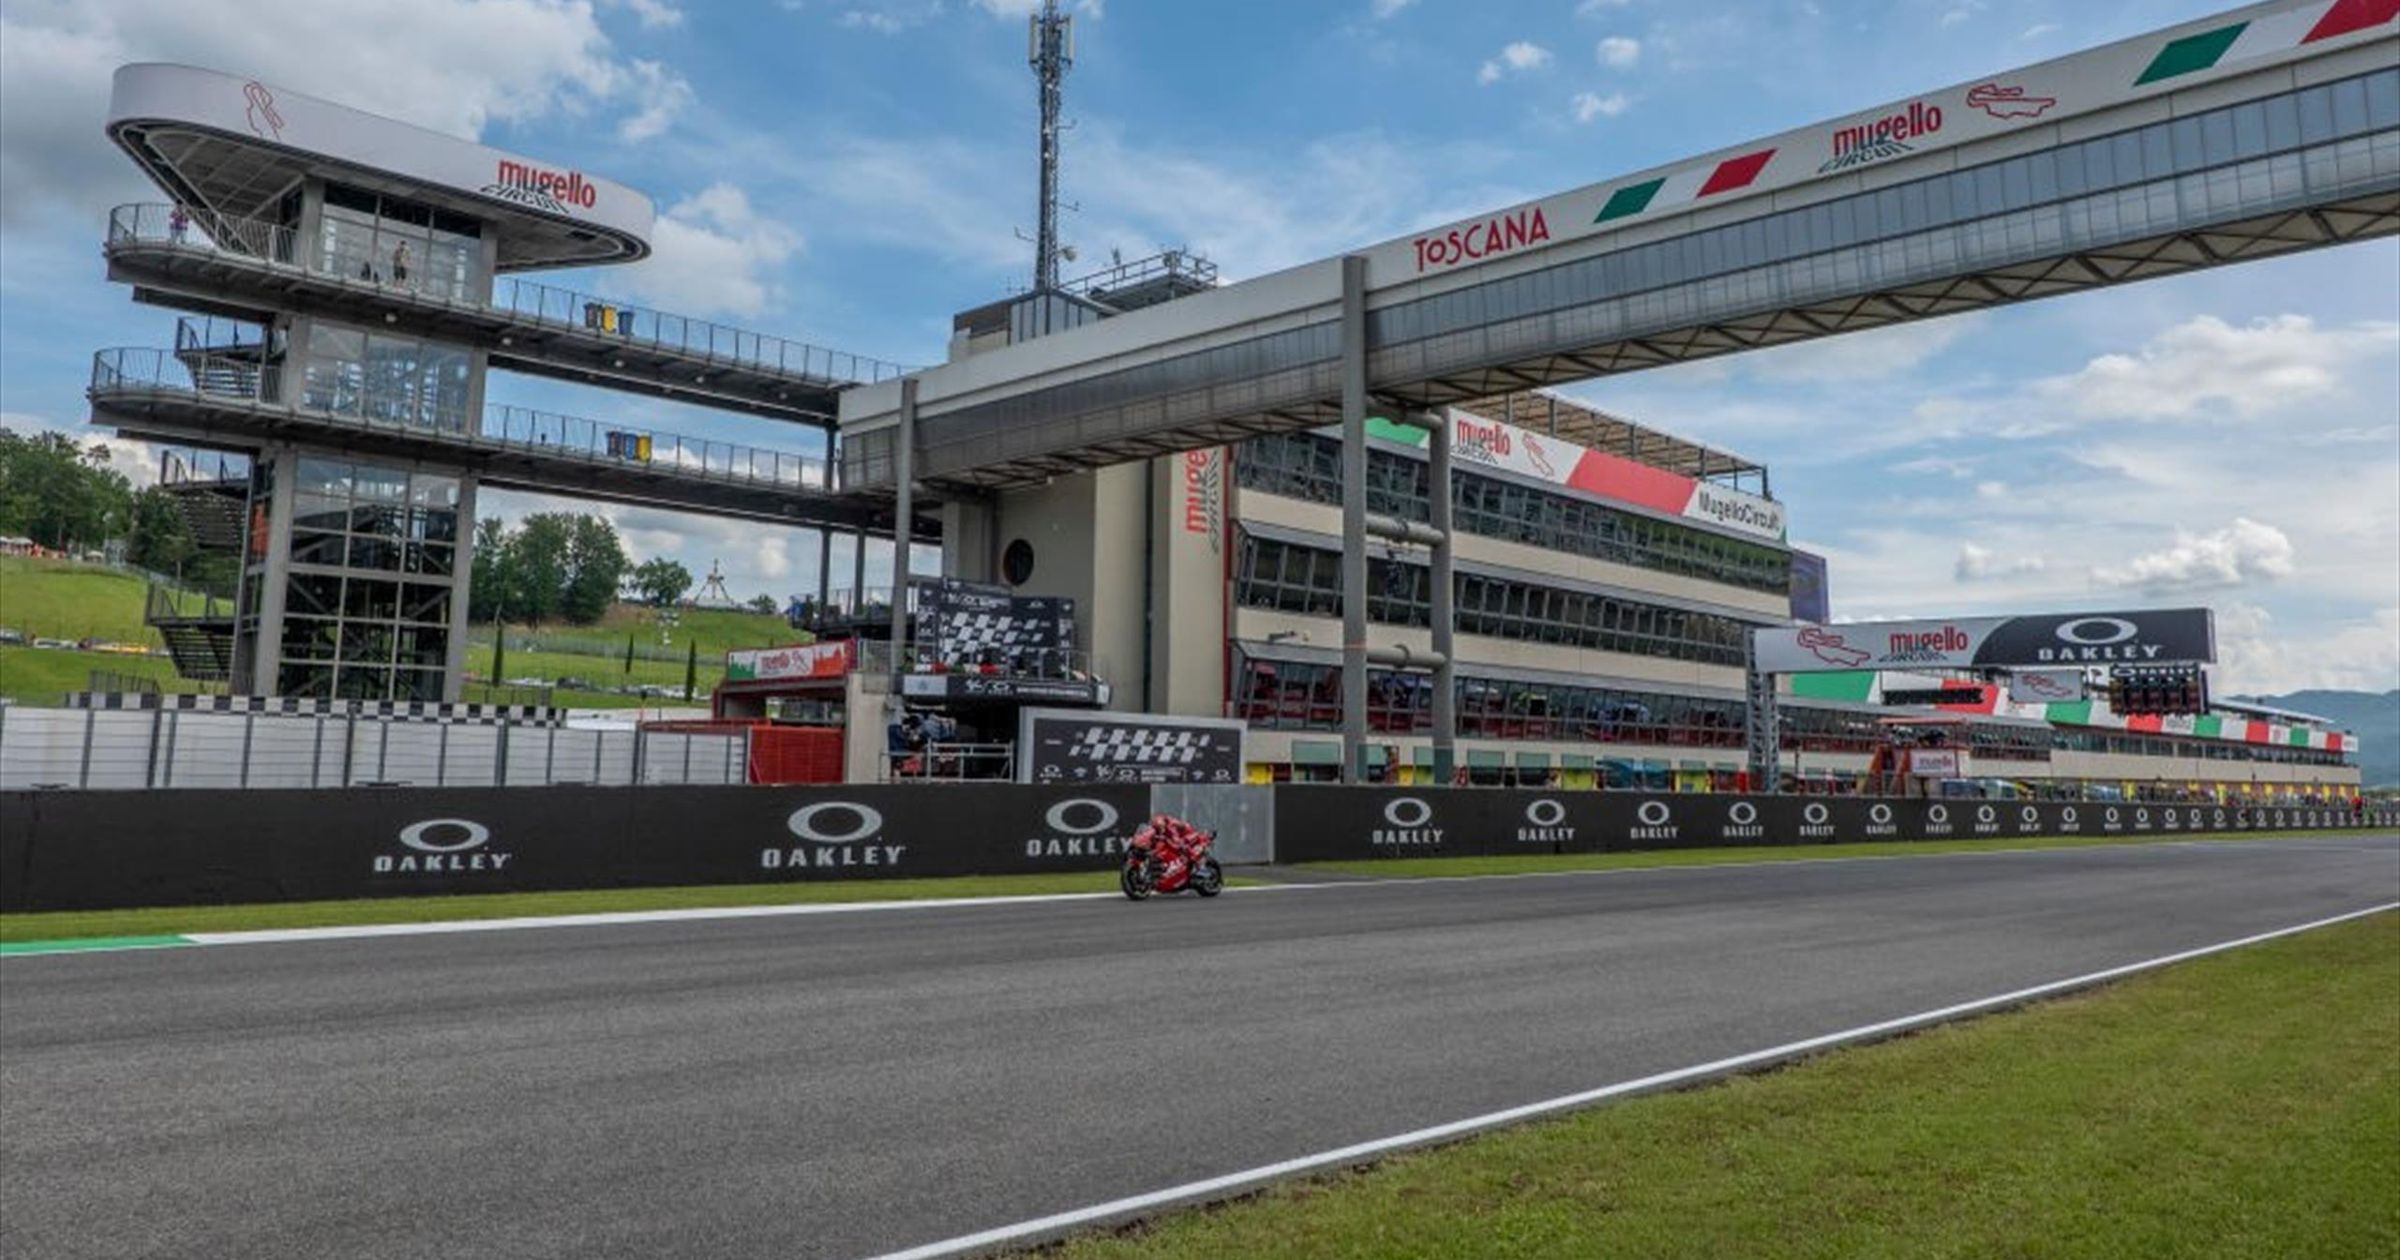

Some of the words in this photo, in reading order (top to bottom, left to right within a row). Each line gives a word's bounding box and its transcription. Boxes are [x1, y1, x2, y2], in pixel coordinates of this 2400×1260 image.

[1833, 101, 1943, 157] mugello
[499, 160, 597, 209] mugello
[1889, 626, 1968, 657] mugello
[2037, 644, 2161, 661] OAKLEY
[1372, 829, 1444, 845] OAKLEY
[1517, 828, 1576, 842] OAKLEY
[1630, 826, 1679, 840] OAKLEY
[1026, 836, 1134, 857] OAKLEY
[373, 853, 511, 872] OAKLEY
[761, 846, 905, 868] OAKLEY
